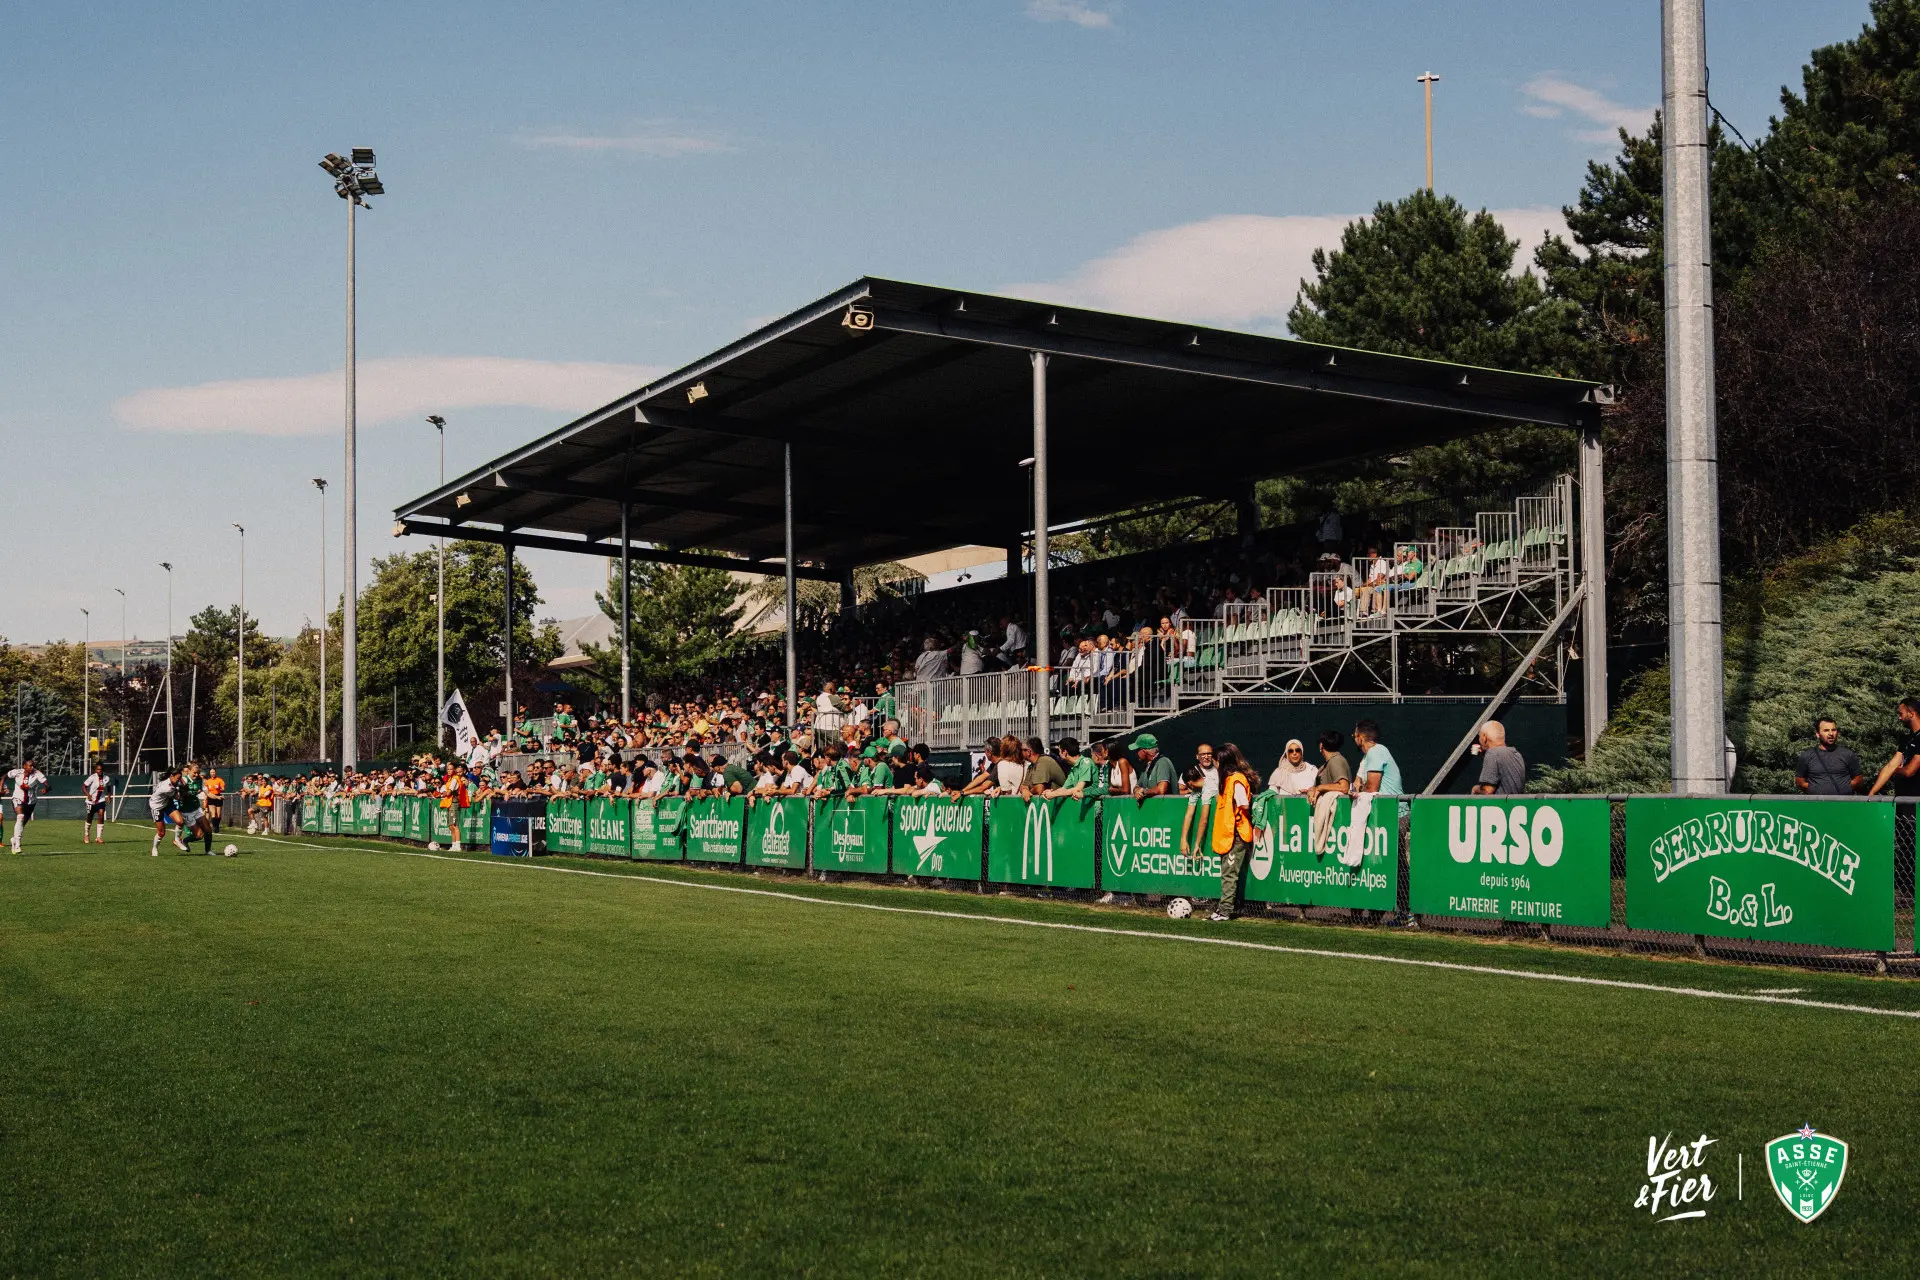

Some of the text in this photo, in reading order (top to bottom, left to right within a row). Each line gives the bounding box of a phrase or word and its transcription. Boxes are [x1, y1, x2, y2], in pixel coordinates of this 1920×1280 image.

[899, 801, 928, 836] sport
[1132, 827, 1172, 848] LOIRE
[1278, 815, 1302, 853] La
[1448, 805, 1564, 867] URSO
[931, 852, 943, 872] pro
[1130, 853, 1222, 878] ASCENSEURS
[1649, 810, 1861, 895] SERRURERIE
[1279, 864, 1387, 892] Auvergne-Rhône-Alpes
[1480, 872, 1531, 891] depuis 1964
[1449, 896, 1563, 918] PLATRERIE PEINTURE
